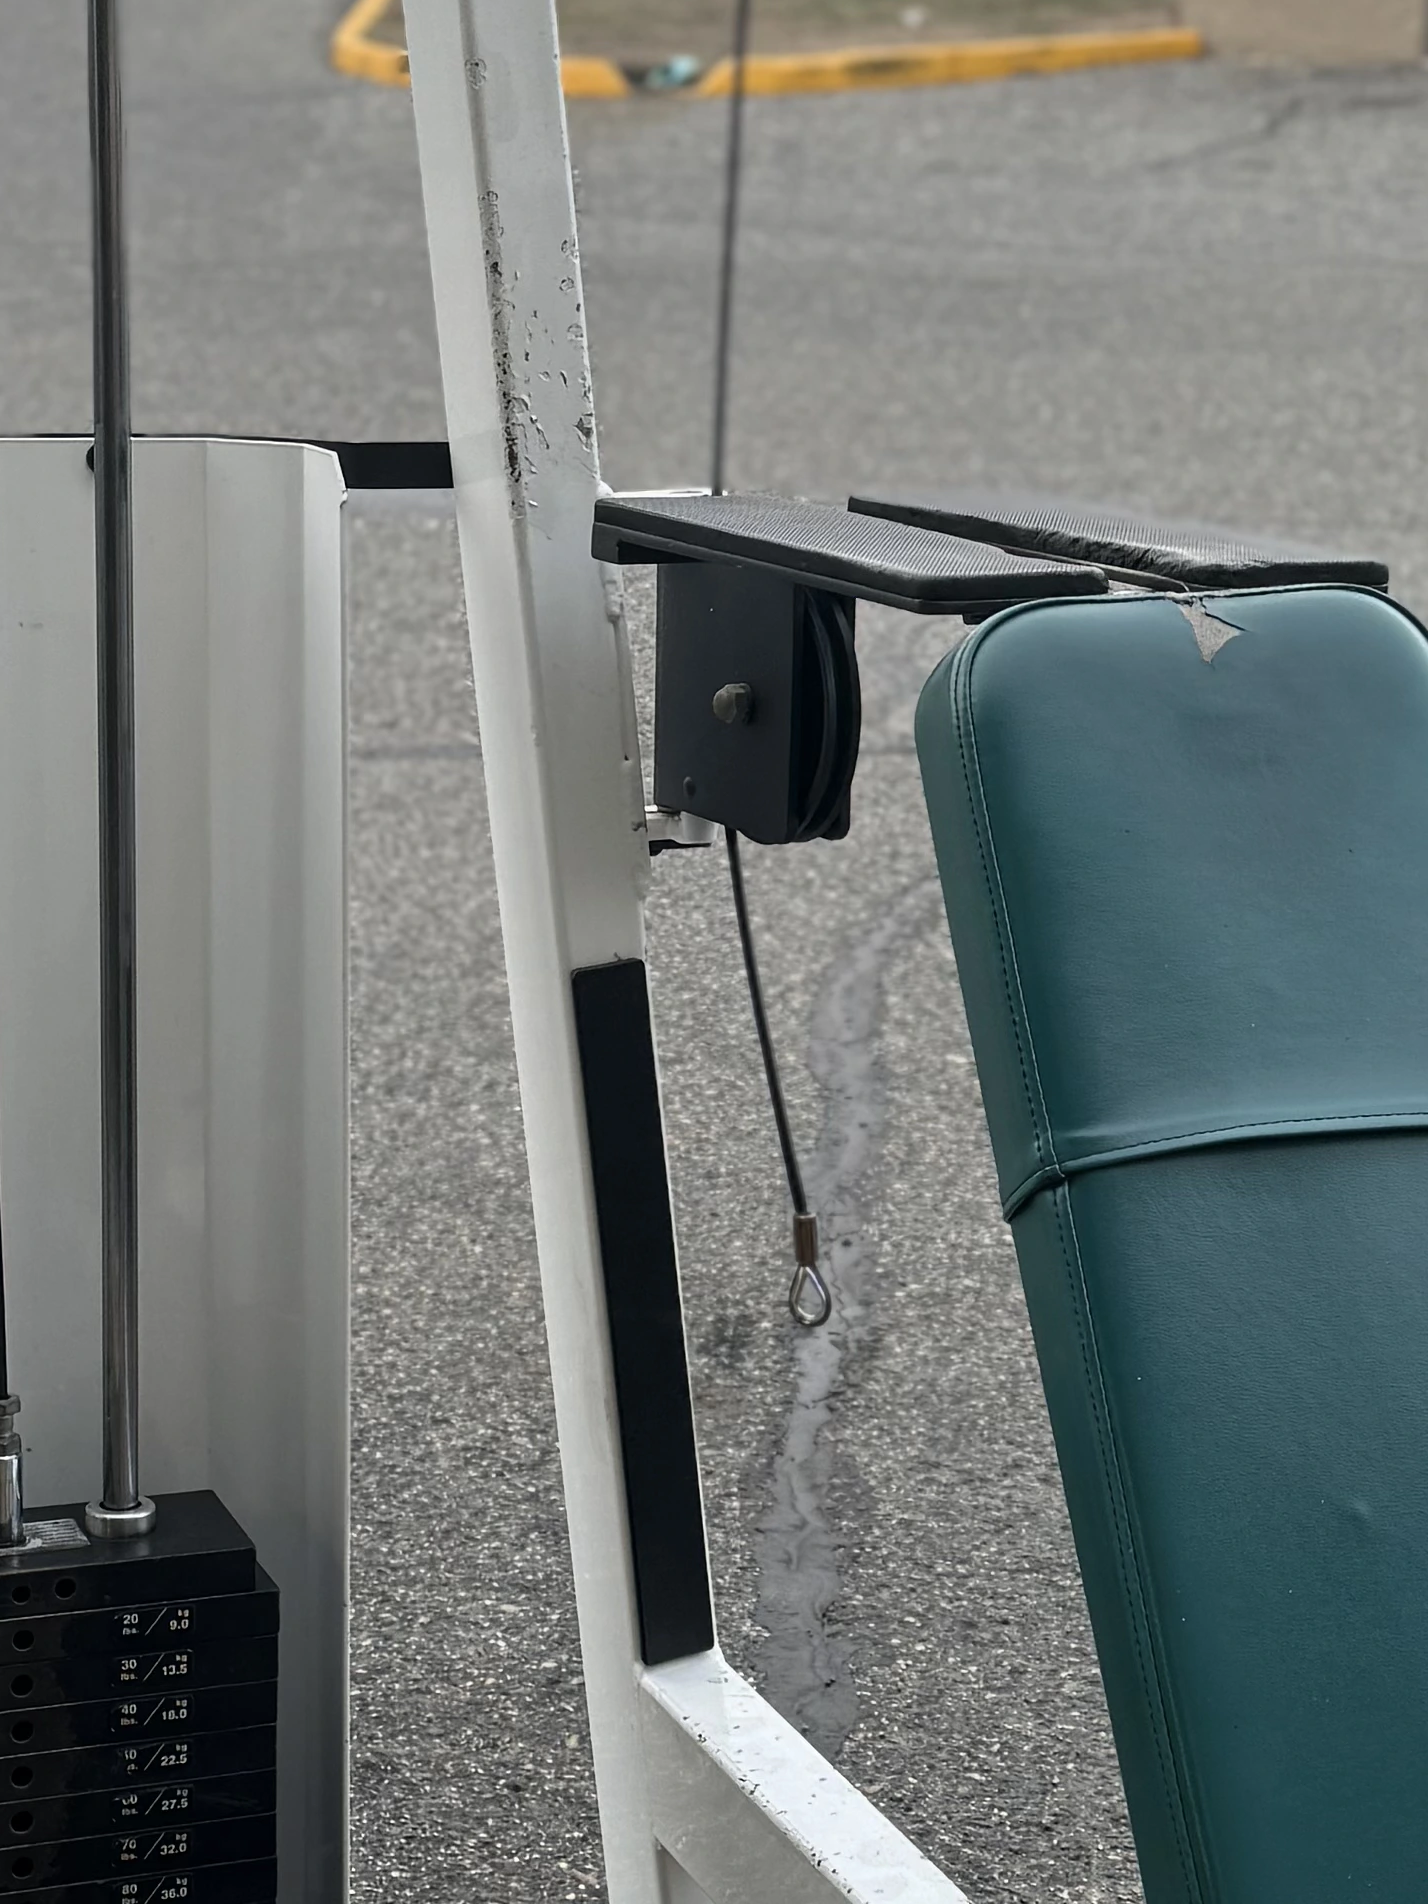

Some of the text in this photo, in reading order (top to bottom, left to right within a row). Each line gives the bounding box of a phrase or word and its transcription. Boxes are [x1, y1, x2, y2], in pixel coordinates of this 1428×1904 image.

[123, 1613, 139, 1625] 20
[169, 1619, 189, 1630] 9.0
[121, 1659, 137, 1670] 30
[162, 1663, 188, 1676] 13.5
[121, 1704, 137, 1715] 40
[162, 1708, 188, 1720] 18.0
[161, 1753, 188, 1766] 22.5
[161, 1798, 188, 1810] 27.5
[122, 1838, 136, 1850] 70
[160, 1842, 187, 1855] 32.0
[122, 1884, 137, 1895] 80
[161, 1887, 187, 1900] 36.0
